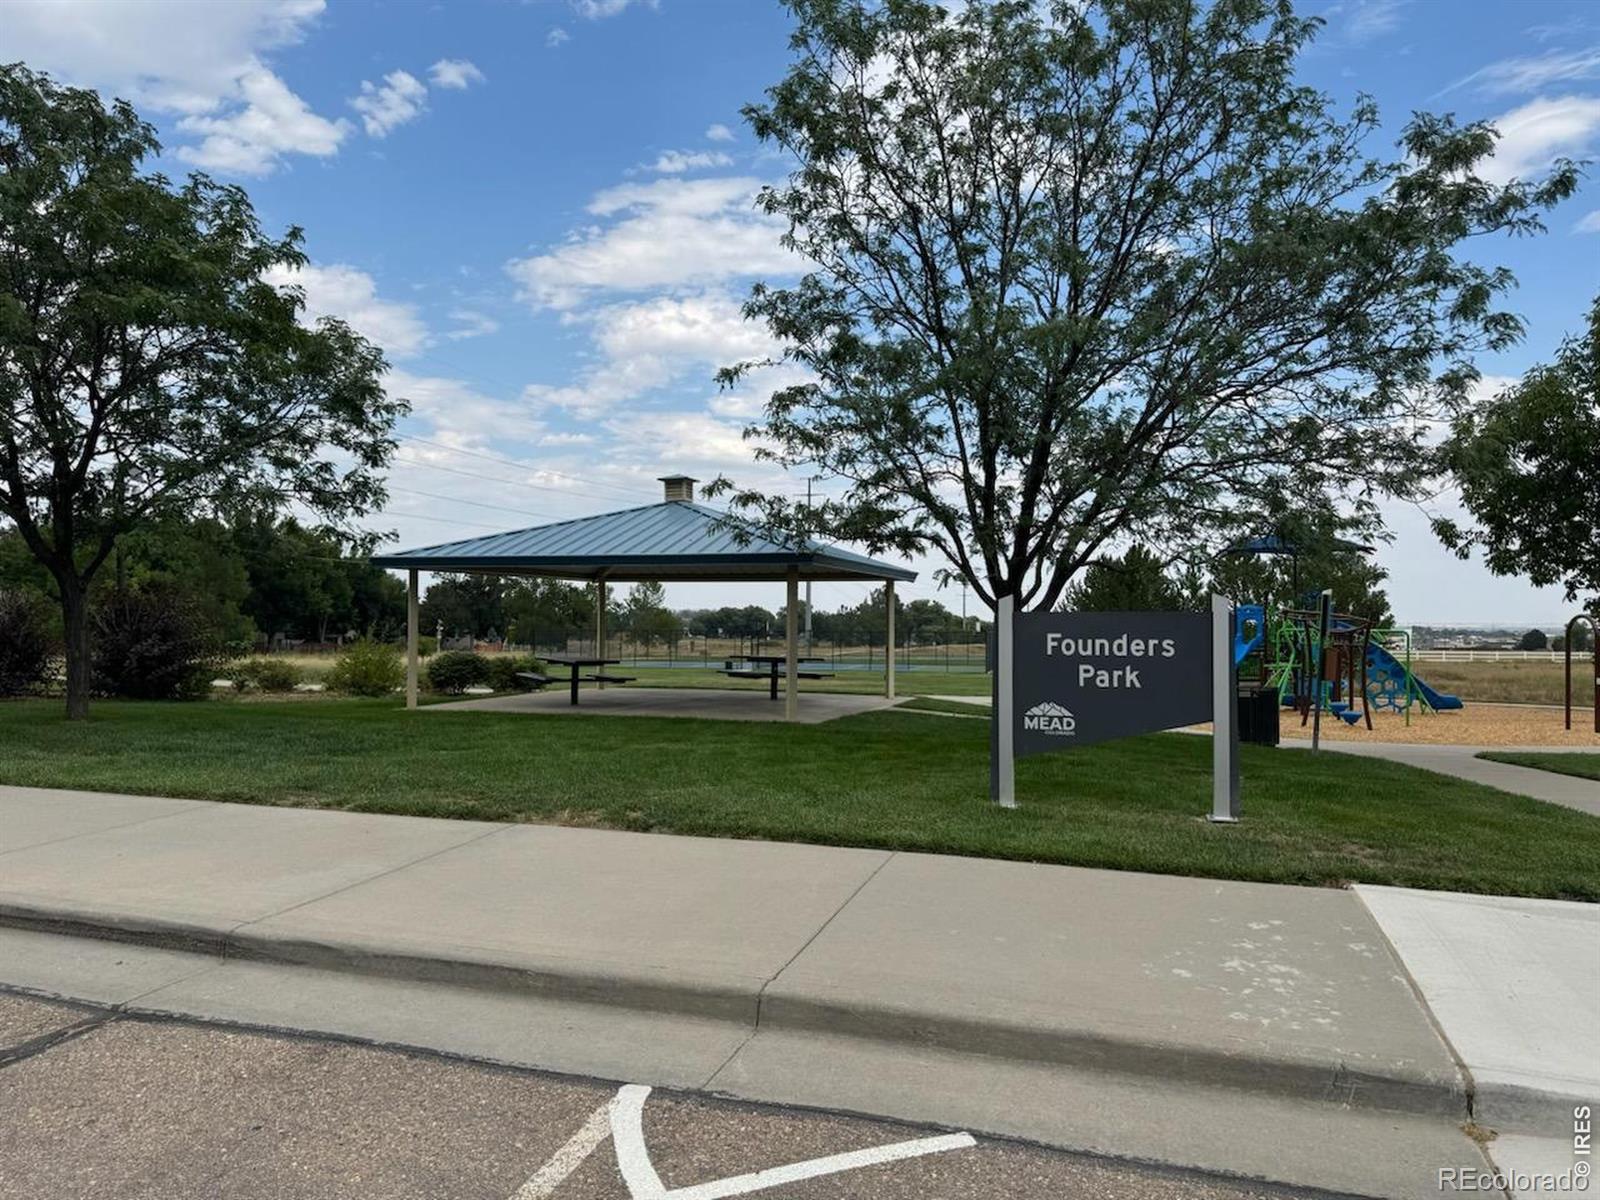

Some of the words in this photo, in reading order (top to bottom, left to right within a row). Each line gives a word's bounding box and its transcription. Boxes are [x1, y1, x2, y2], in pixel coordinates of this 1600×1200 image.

[1046, 633, 1175, 657] Founders
[1078, 664, 1141, 688] Park
[1024, 716, 1075, 730] MEAD
